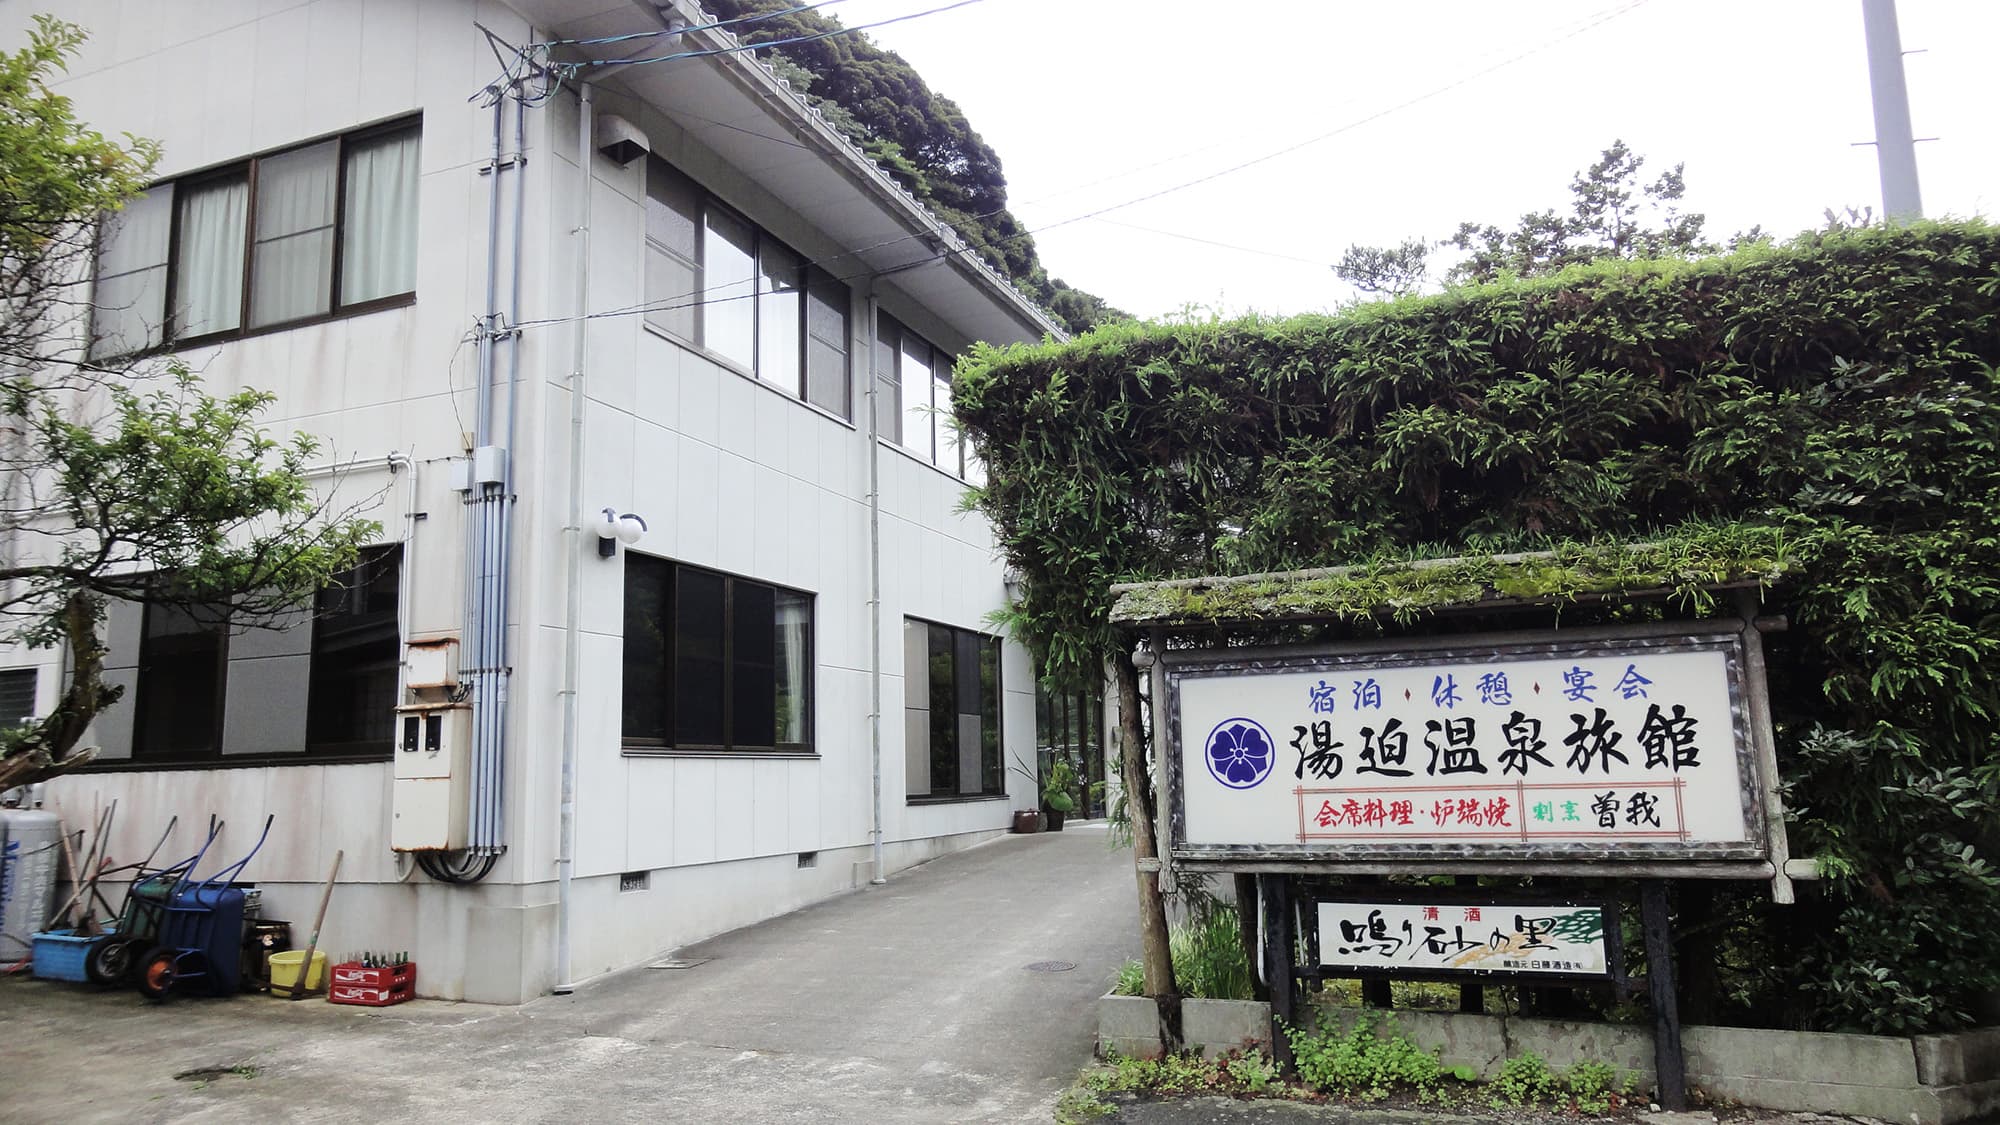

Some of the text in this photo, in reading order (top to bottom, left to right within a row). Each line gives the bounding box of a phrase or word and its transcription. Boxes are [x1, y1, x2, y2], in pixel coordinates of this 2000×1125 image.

[1289, 703, 1701, 780] 湯迫温泉旅館
[1338, 909, 1558, 963] 鳴り砂の里
[1423, 906, 1481, 922] 清酒
